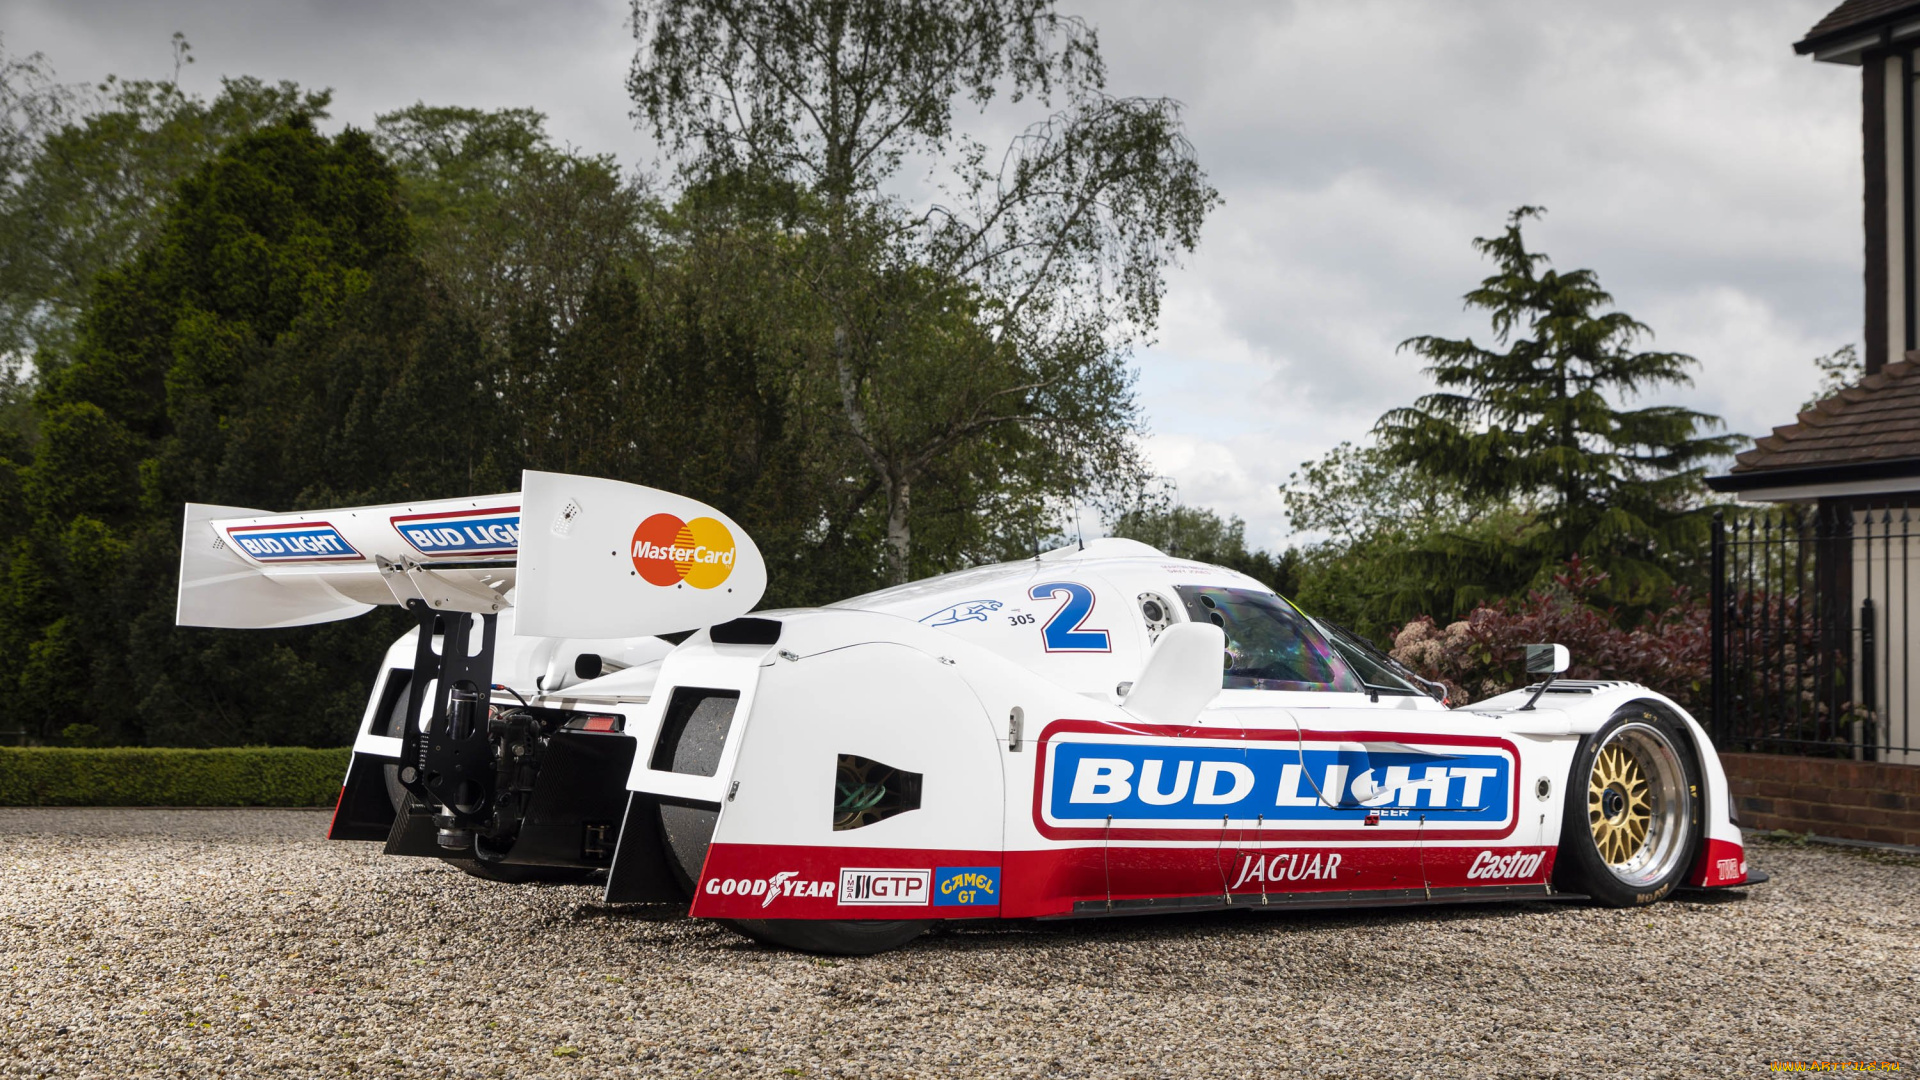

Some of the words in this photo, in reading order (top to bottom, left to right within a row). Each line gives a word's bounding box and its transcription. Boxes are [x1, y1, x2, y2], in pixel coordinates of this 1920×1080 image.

[240, 537, 285, 554] BUD
[281, 534, 343, 553] LIGHT
[407, 527, 466, 547] BUD
[463, 523, 520, 545] LIGH
[632, 540, 734, 565] MasterCard
[1008, 614, 1035, 626] 305
[1028, 581, 1112, 653] 2
[1069, 757, 1256, 806] BUD
[1275, 763, 1497, 807] LIGHT
[1231, 853, 1342, 889] JAGUAR
[1466, 850, 1547, 879] Castrol
[871, 877, 923, 897] GTP
[941, 873, 994, 895] CAMEL
[958, 890, 976, 904] GT
